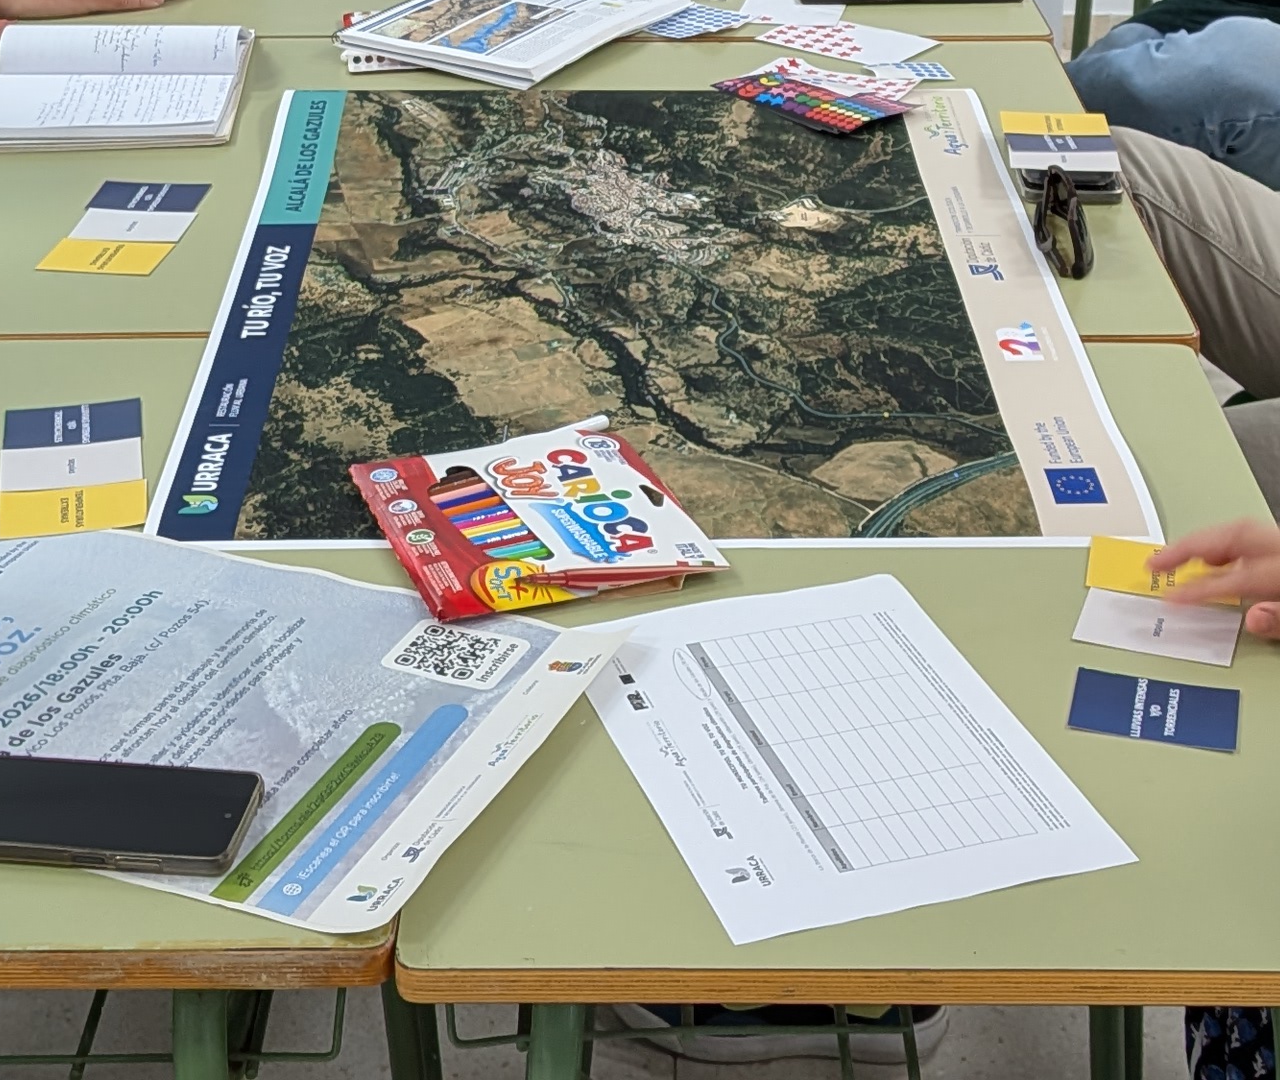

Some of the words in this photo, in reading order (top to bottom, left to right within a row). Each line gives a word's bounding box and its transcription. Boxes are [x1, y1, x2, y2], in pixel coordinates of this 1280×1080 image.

[302, 100, 327, 141] GAZULES
[294, 163, 314, 176] DE
[298, 142, 318, 162] LOS
[285, 177, 310, 212] ALCALÁ
[261, 245, 291, 271] VOZ
[255, 272, 283, 290] TU
[243, 291, 282, 318] RÍO,
[240, 319, 269, 339] TU
[192, 433, 231, 491] URRACA
[493, 456, 559, 500] JOY
[546, 448, 655, 554] CARIOCA
[551, 507, 608, 560] SUPERWASHABLE
[7, 625, 70, 675] diagnóstico
[68, 588, 116, 625] climático
[102, 590, 162, 634] 20:00h
[43, 720, 69, 738] Los
[63, 693, 103, 720] Pozos,
[118, 653, 148, 673] Baja.
[158, 614, 192, 638] Pozos
[475, 643, 519, 683] Inscribirse
[8, 728, 35, 747] de
[27, 706, 61, 727] los
[56, 653, 122, 703] Gazules
[1162, 686, 1181, 738] TORRENCIALES
[746, 855, 771, 887] URRACA
